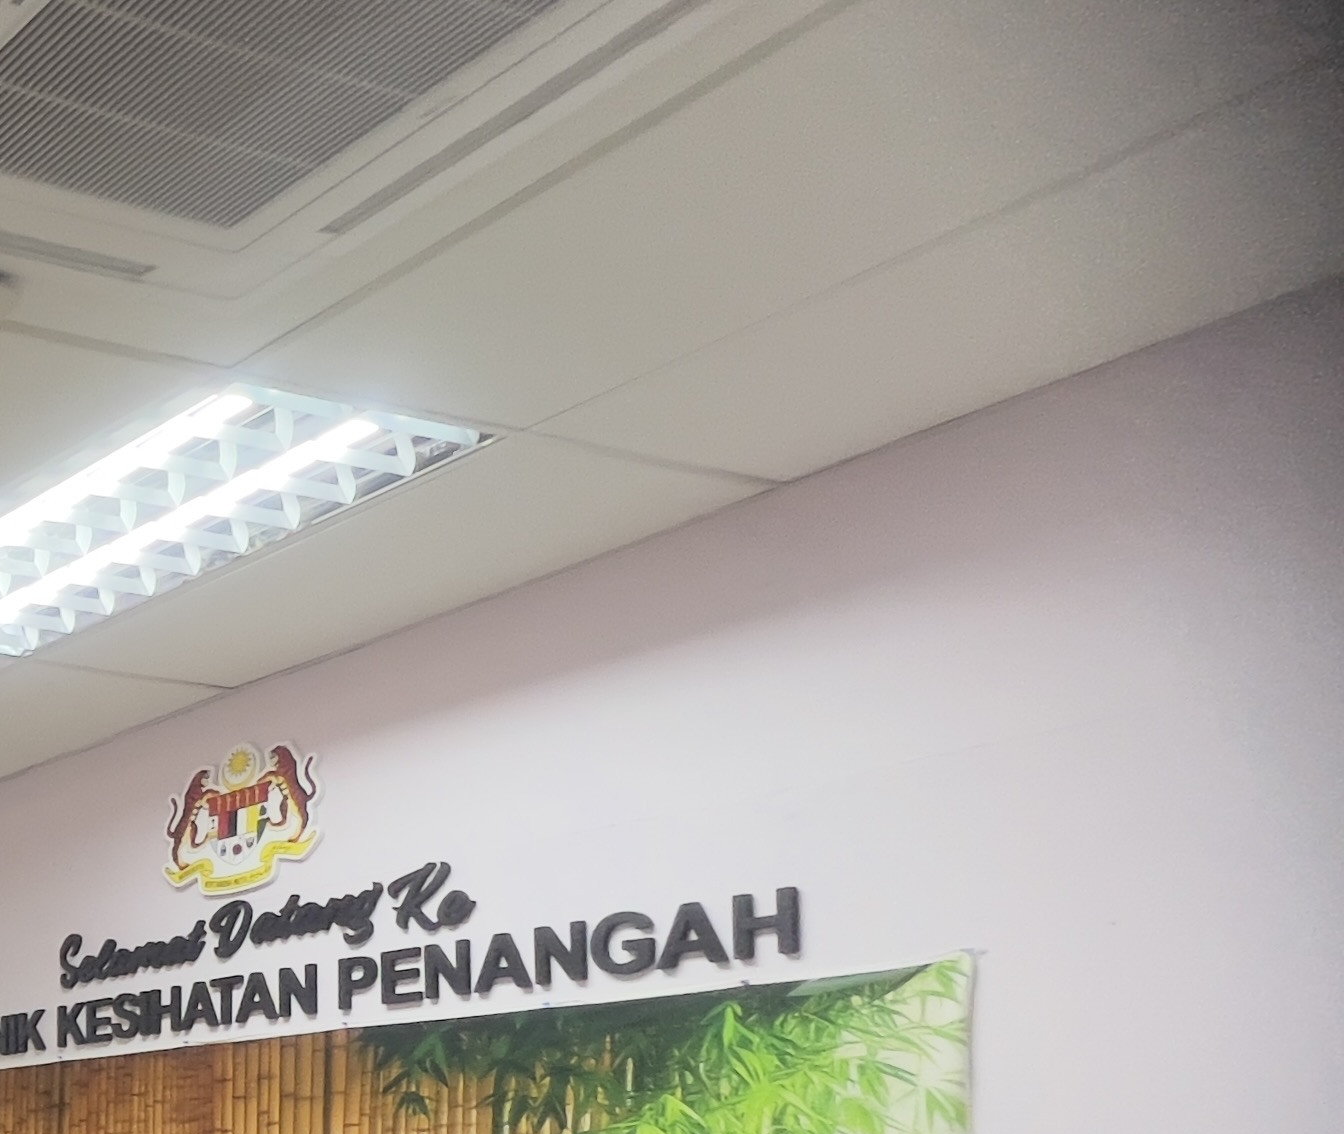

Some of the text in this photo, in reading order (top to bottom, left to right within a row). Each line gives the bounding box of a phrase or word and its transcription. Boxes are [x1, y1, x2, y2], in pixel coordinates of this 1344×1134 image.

[57, 963, 318, 1047] KESIHATAN
[338, 886, 801, 1011] PENANGAH
[59, 861, 477, 989] Selamat Datang Ke
